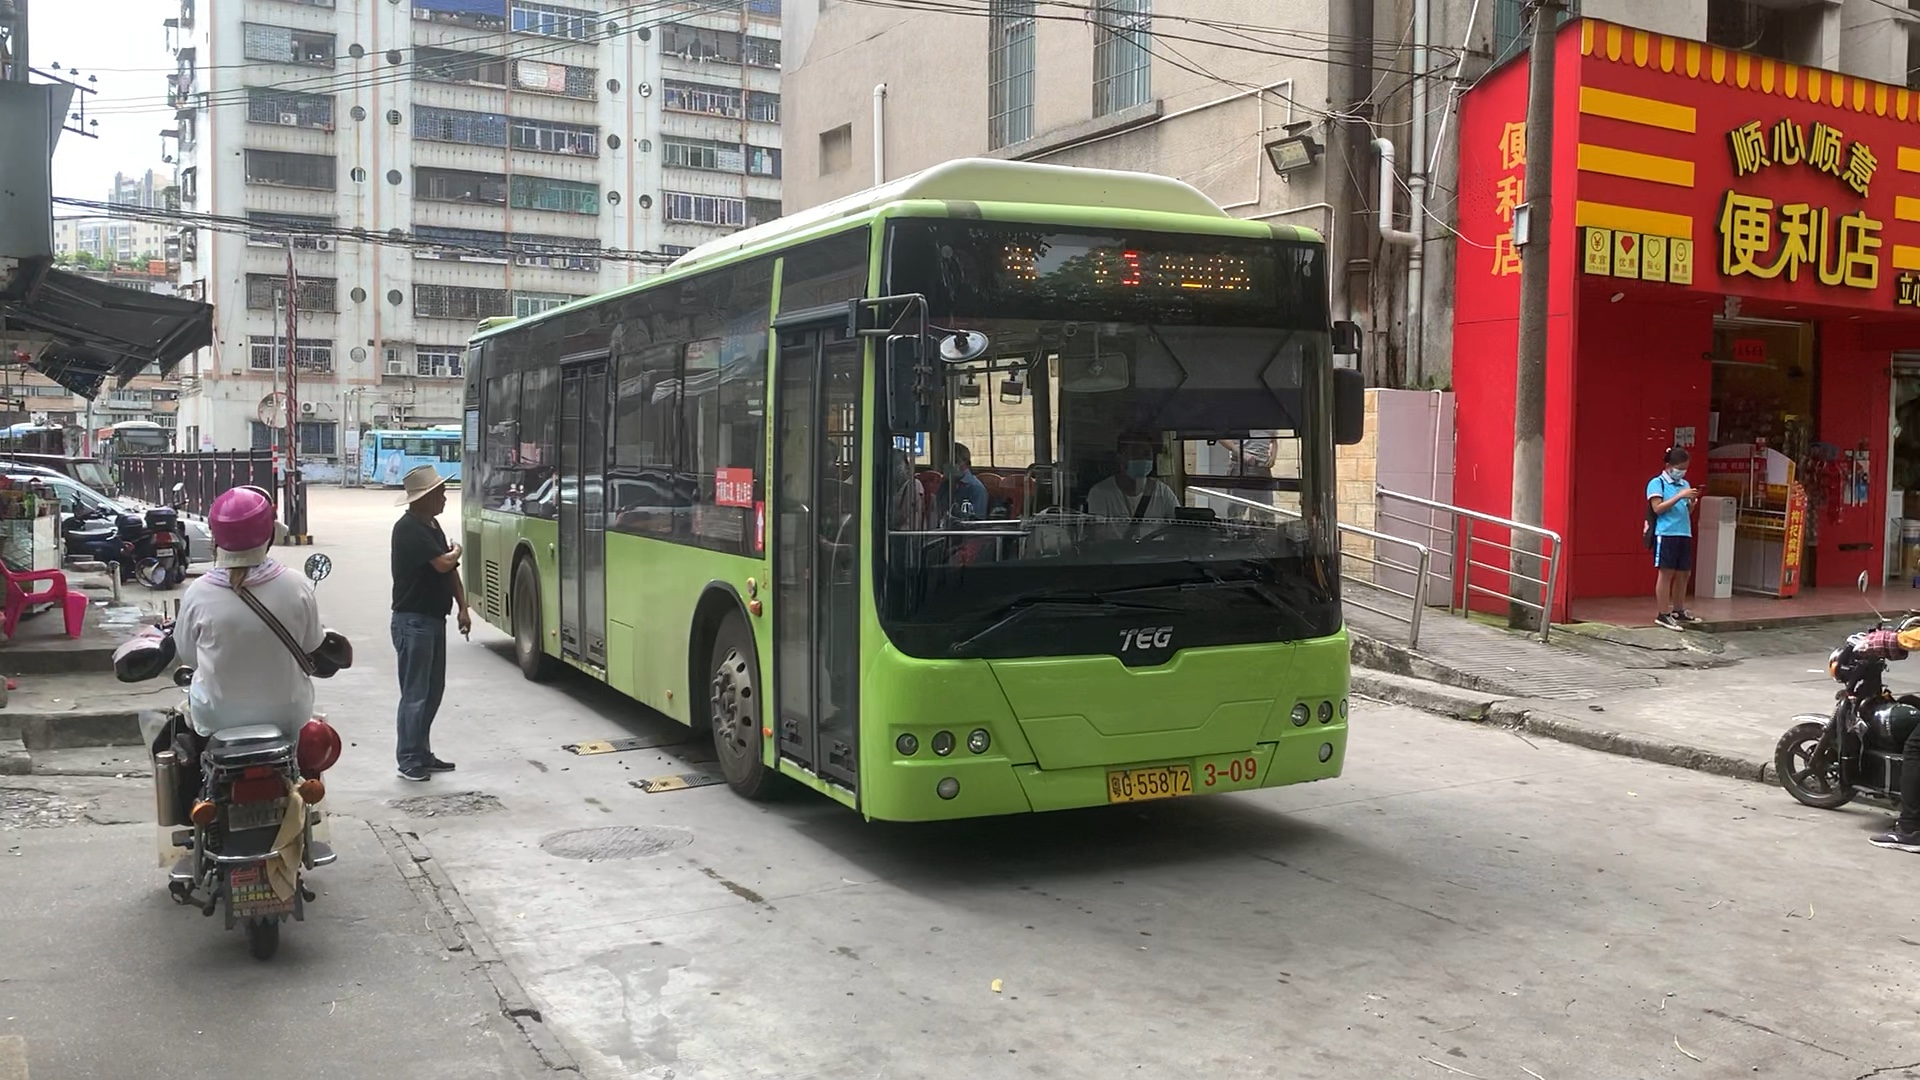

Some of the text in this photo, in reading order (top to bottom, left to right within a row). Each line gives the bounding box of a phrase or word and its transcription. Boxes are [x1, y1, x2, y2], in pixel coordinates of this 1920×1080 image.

[1731, 119, 1878, 197] 顺心顺意
[1491, 122, 1528, 277] 便利店
[1720, 189, 1884, 290] 便利店
[1119, 626, 1174, 651] TEG
[1203, 757, 1258, 787] 3-09
